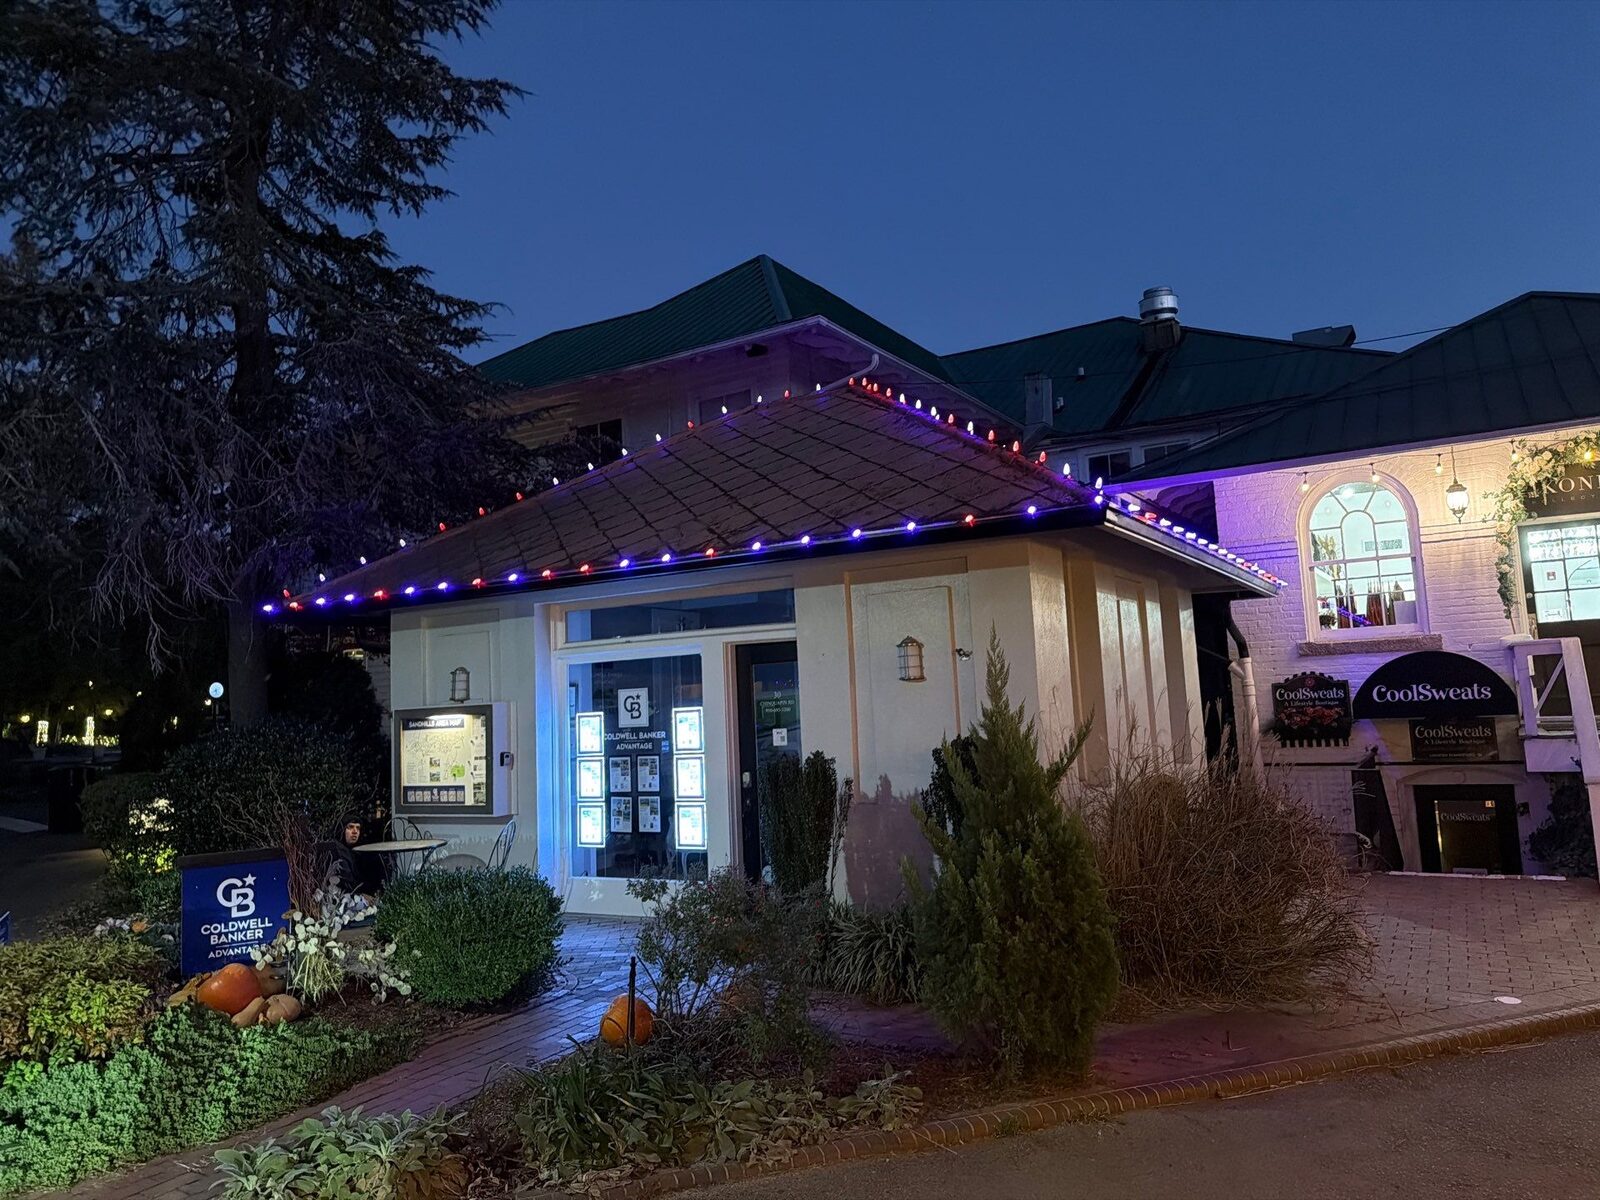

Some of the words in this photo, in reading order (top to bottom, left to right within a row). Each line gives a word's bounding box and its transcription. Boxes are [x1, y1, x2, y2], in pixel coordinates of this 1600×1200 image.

[1276, 687, 1345, 701] CoolSweats
[1371, 682, 1492, 703] CoolSweats
[638, 730, 666, 740] BANKER
[1415, 724, 1492, 739] CoolSweats
[616, 742, 653, 751] ADVANTAGE
[201, 917, 272, 935] COLDWELL
[210, 929, 263, 945] BANKER
